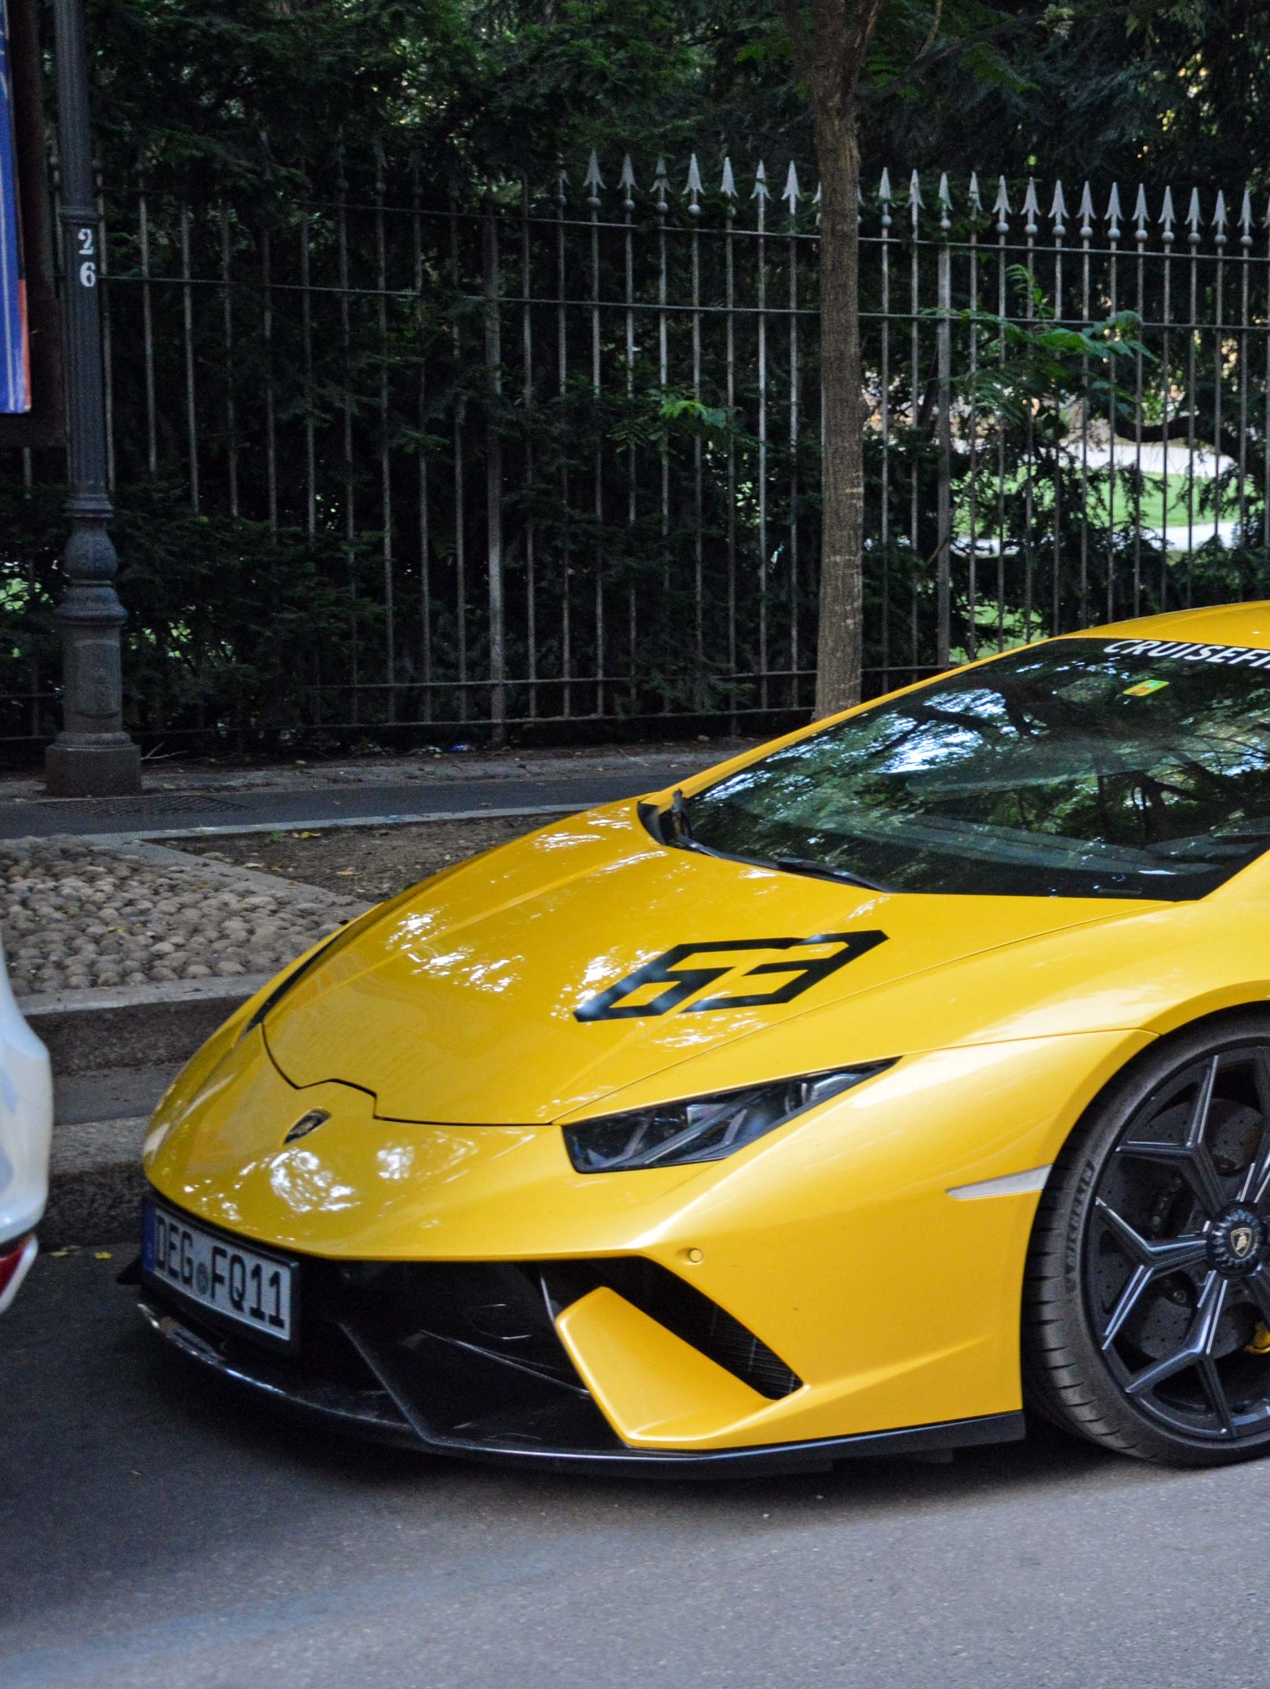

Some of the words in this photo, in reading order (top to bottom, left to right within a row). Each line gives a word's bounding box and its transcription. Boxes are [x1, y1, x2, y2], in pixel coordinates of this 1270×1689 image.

[573, 929, 890, 1023] 63
[156, 1214, 193, 1287] DEG
[211, 1245, 285, 1329] FQ11
